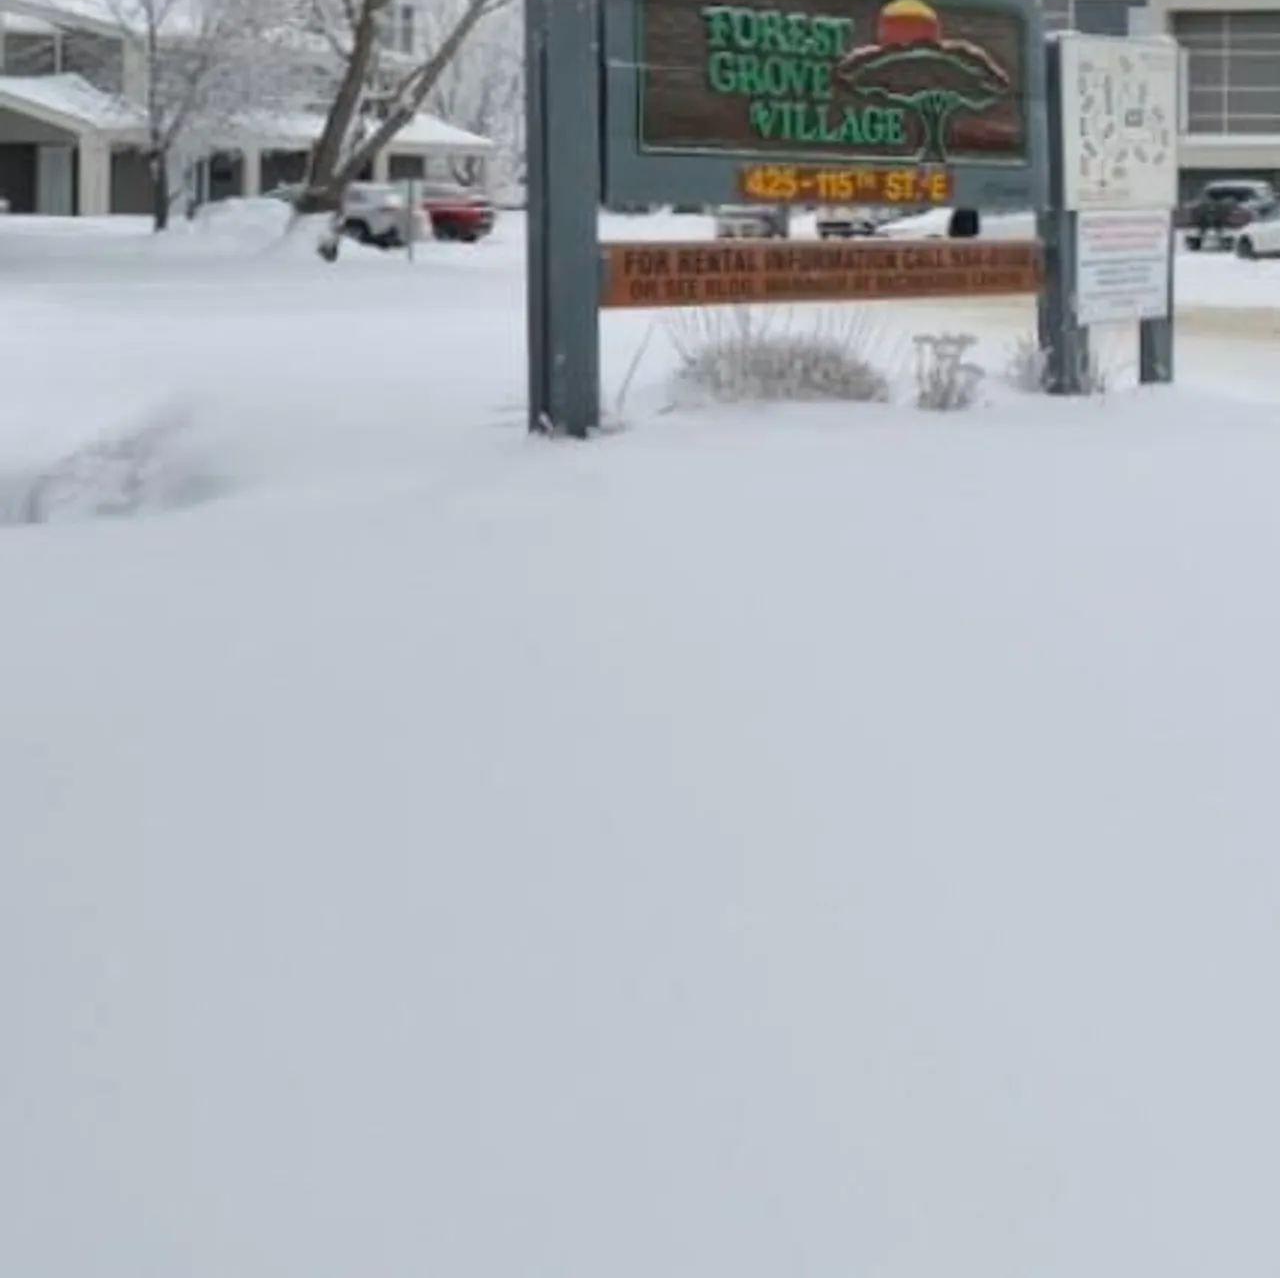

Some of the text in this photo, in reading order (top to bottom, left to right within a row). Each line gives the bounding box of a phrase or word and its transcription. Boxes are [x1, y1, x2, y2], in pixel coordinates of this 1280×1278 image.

[701, 6, 854, 57] FOREST
[709, 51, 832, 99] GROVE
[751, 98, 908, 145] VILLAGE
[623, 250, 670, 276] FOR
[677, 248, 758, 273] RENTAL
[766, 247, 898, 272] INFORMATION
